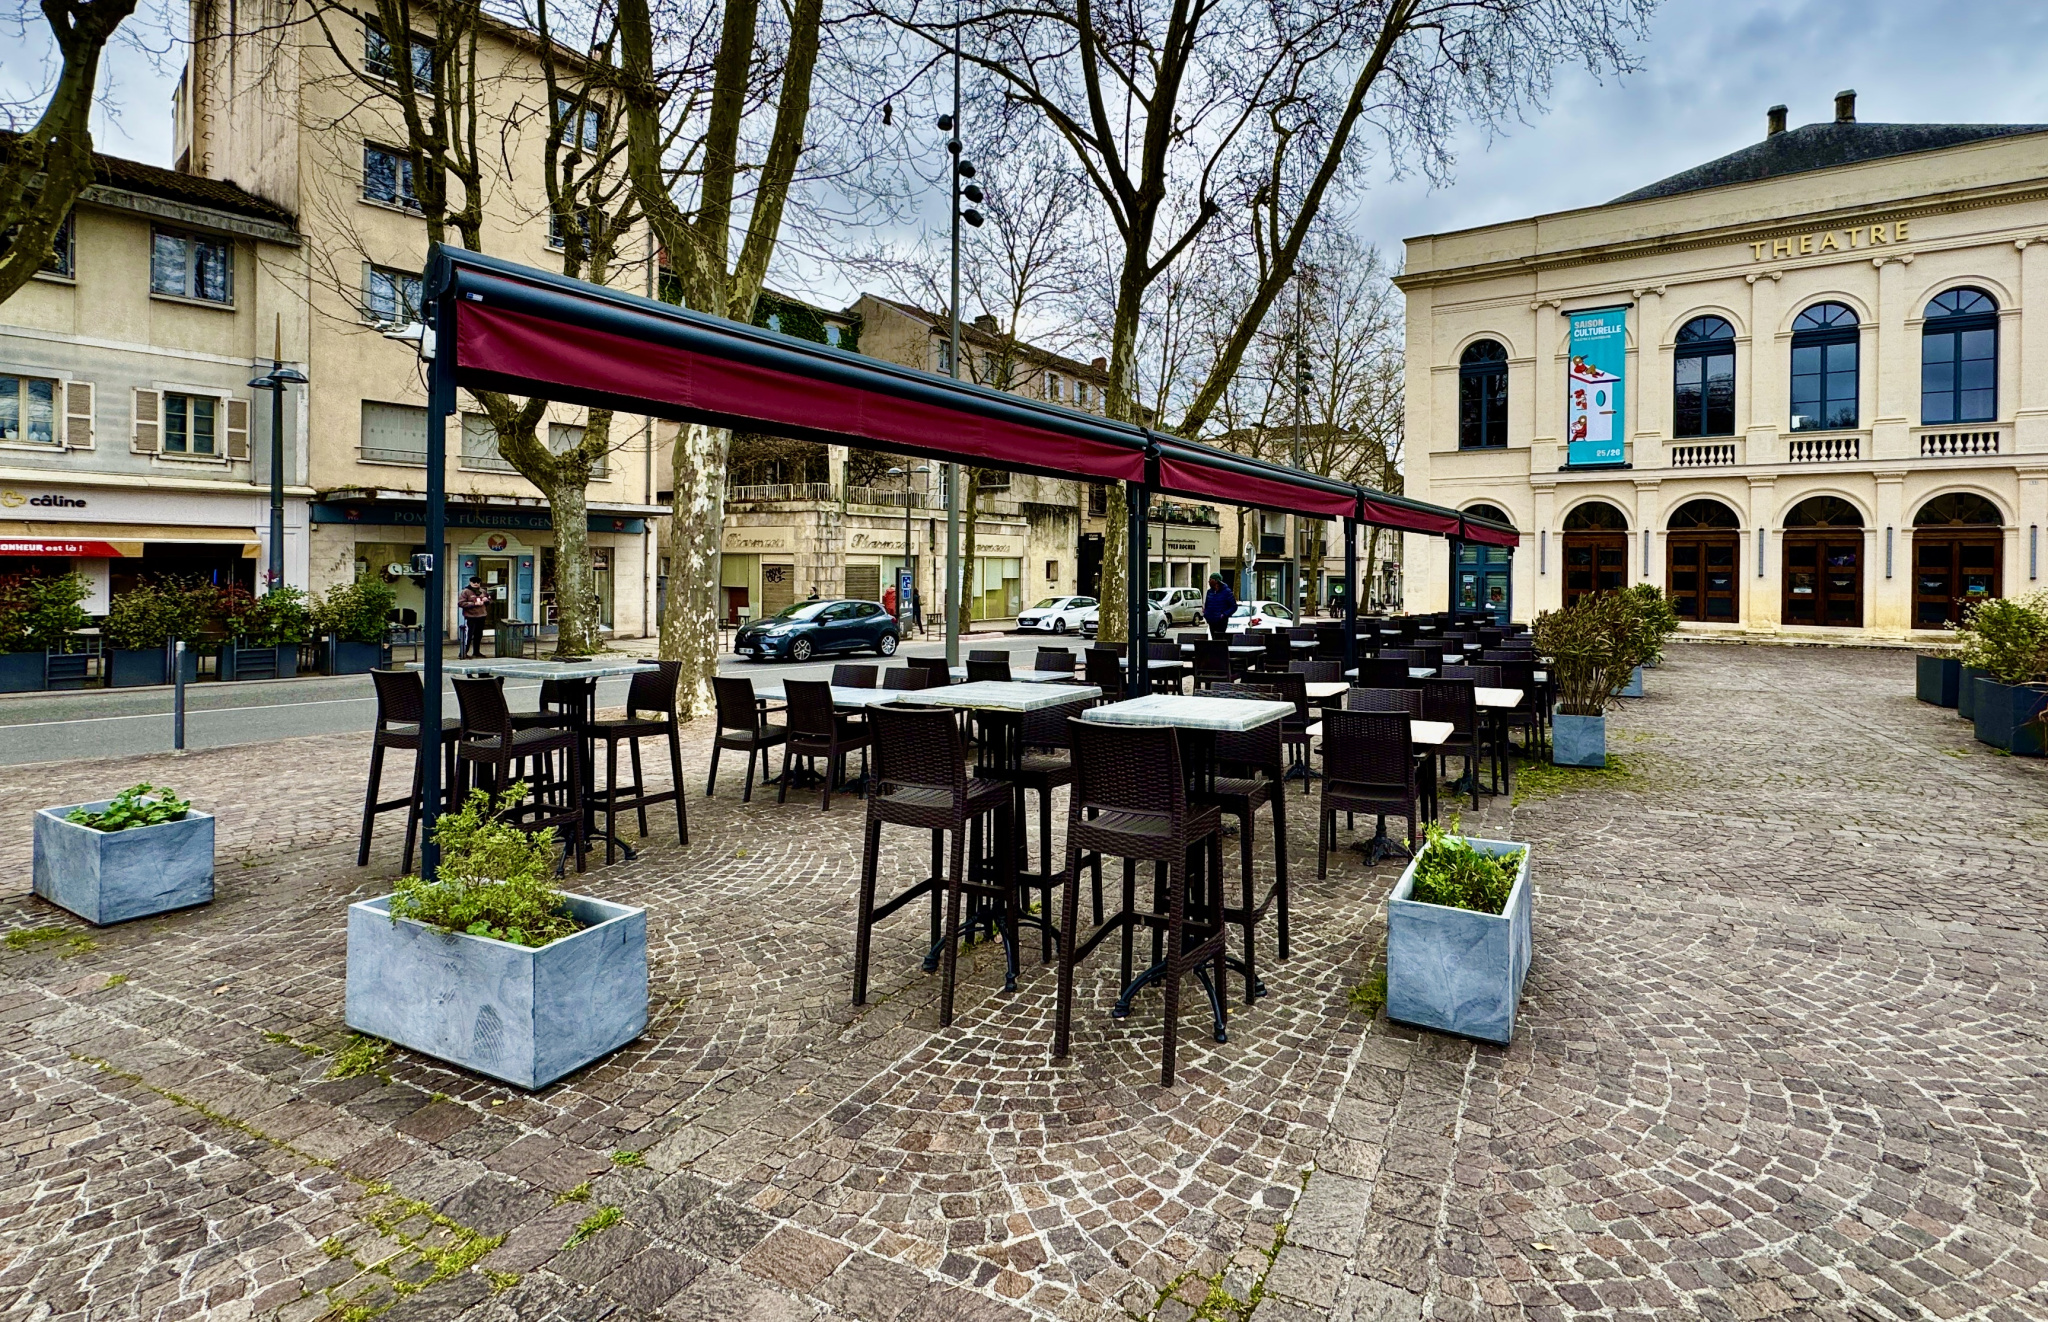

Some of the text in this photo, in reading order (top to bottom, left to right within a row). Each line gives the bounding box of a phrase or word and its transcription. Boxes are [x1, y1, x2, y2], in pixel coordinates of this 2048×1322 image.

[1750, 220, 1909, 261] THEATRE
[1574, 318, 1604, 329] SAISON
[1574, 325, 1622, 337] CULTURELLE
[1596, 449, 1621, 457] 25/26
[30, 494, 87, 508] câline
[394, 511, 450, 524] POMS
[851, 533, 915, 549] Pharmace
[0, 543, 44, 552] ONHEUR
[65, 544, 77, 552] là
